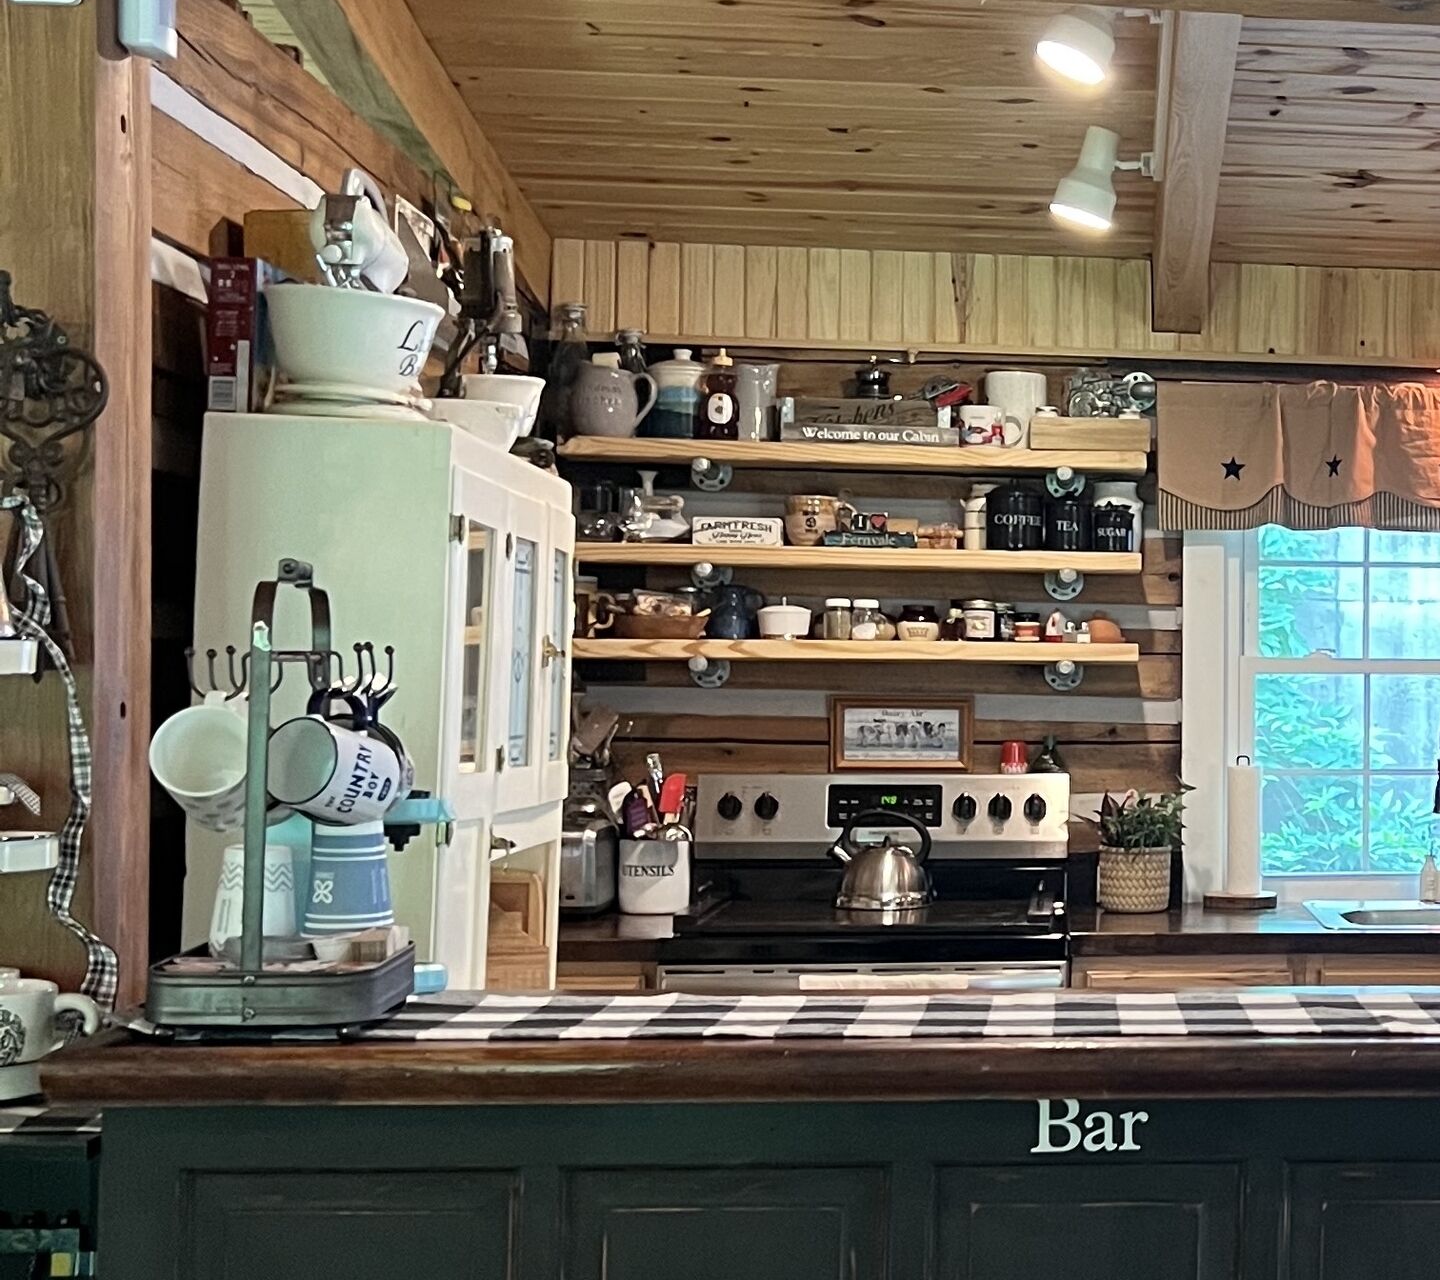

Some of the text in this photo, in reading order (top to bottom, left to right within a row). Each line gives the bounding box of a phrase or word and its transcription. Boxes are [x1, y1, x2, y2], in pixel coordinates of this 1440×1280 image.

[802, 426, 940, 443] Welcome to our Cabin
[858, 515, 864, 528] I
[993, 513, 1042, 527] COFFEE
[1056, 519, 1079, 531] TEA
[1097, 526, 1127, 537] SUGAR
[840, 532, 896, 546] Fernvale
[337, 744, 372, 812] COUNTRY
[363, 772, 378, 798] BOY
[622, 864, 675, 877] UTENSILS
[1030, 1098, 1150, 1154] Bar
